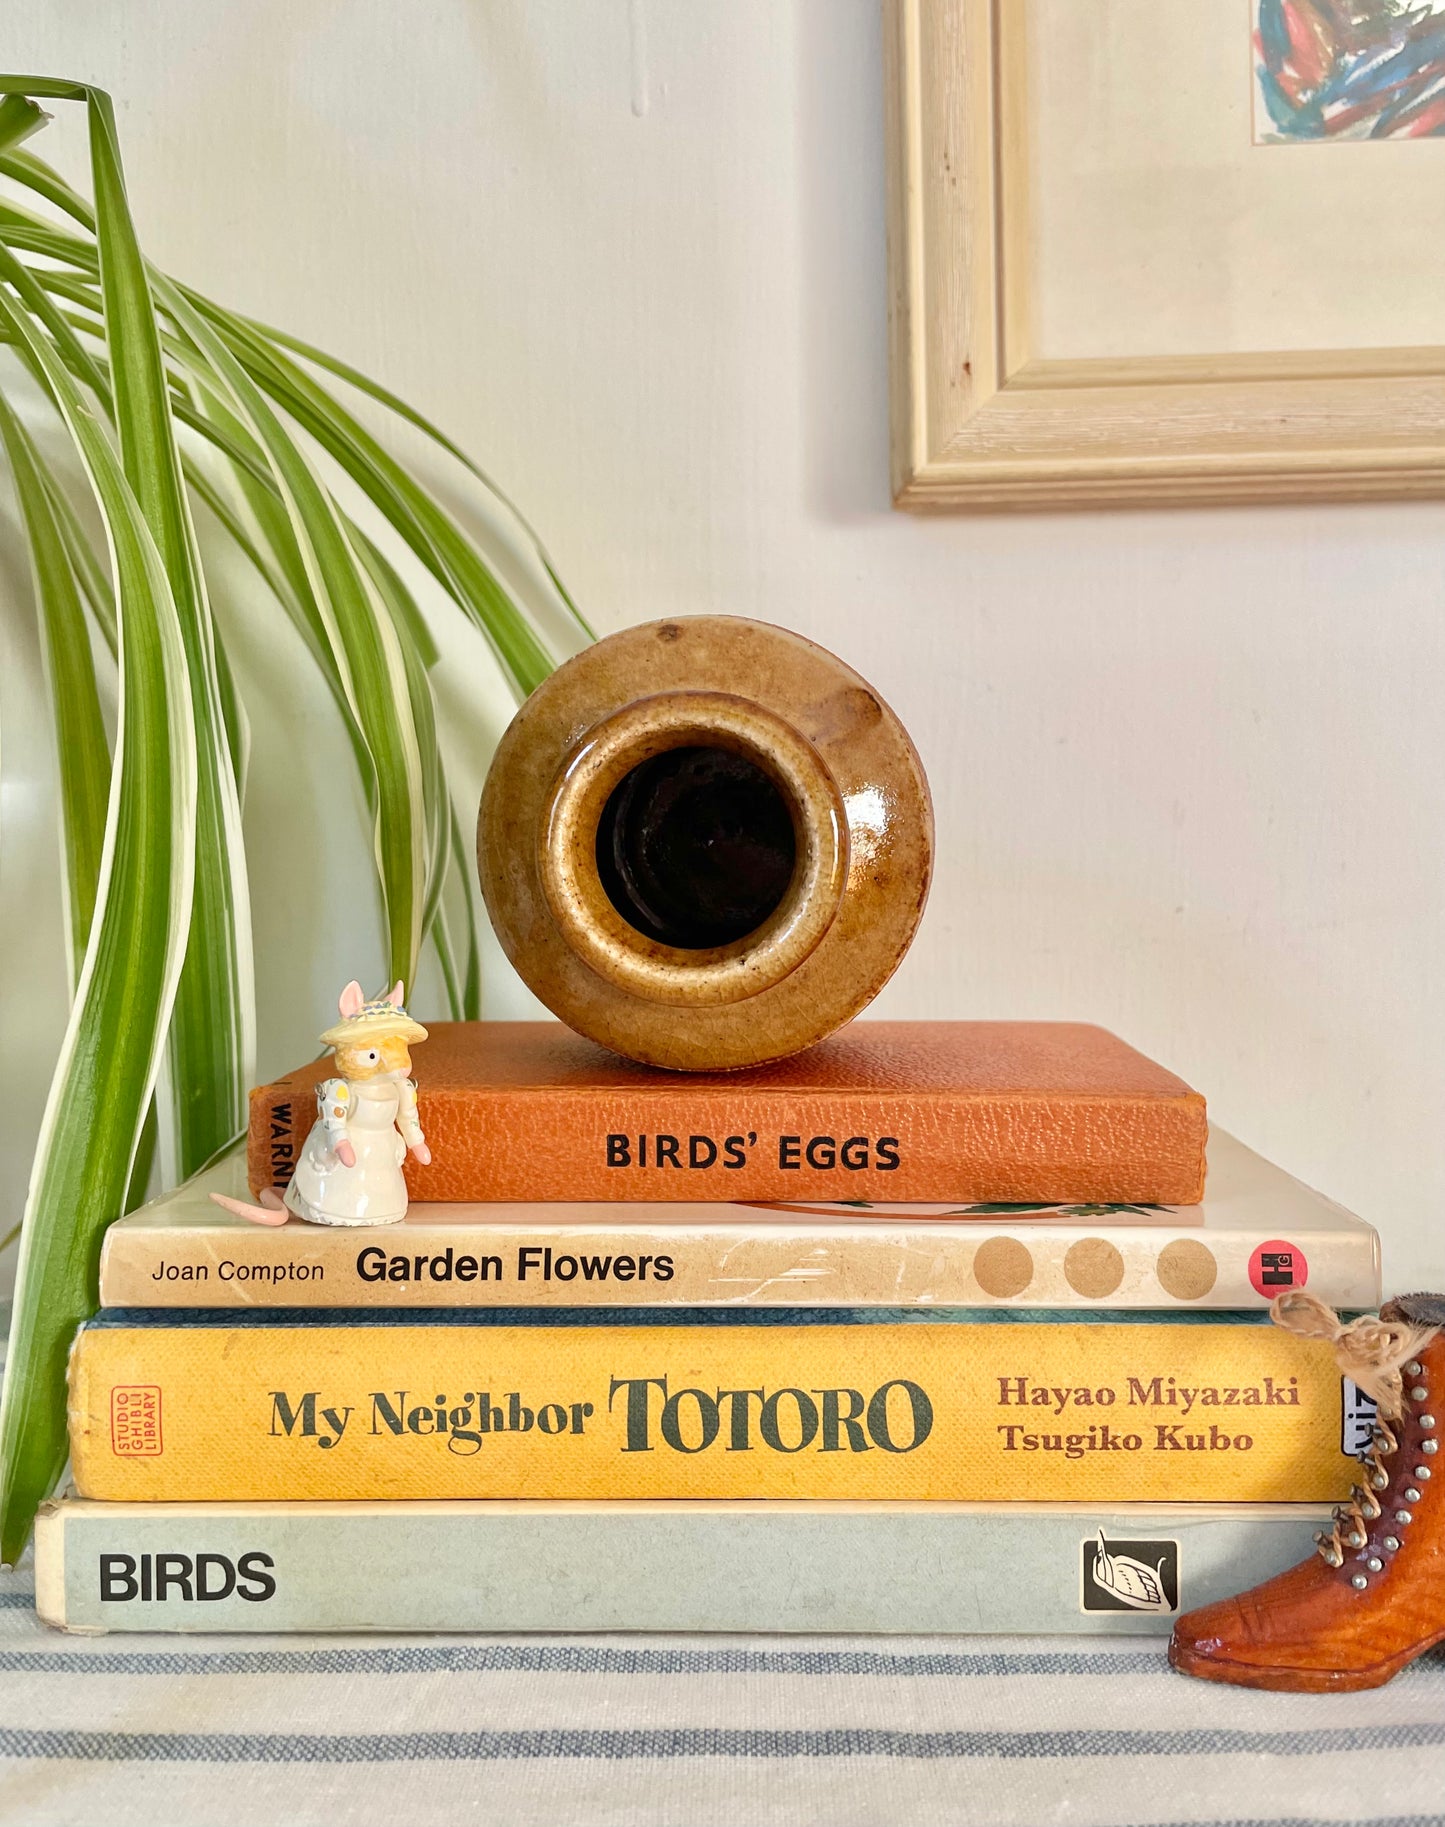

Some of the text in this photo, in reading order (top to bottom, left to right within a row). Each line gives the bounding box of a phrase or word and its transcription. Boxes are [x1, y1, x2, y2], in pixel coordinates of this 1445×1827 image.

[271, 1103, 293, 1188] WARN
[779, 1135, 901, 1170] EGGS
[152, 1260, 325, 1285] Joan Compton
[356, 1247, 675, 1282] Garden Flowers
[267, 1373, 934, 1455] My Neighbor TOTORO
[997, 1376, 1300, 1415] Hayao Miyazaki
[117, 1393, 130, 1450] STUDIO
[130, 1393, 143, 1450] GHIBLI
[144, 1393, 157, 1450] LIBRARY
[997, 1425, 1254, 1459] Tsugiko Kubo
[100, 1552, 276, 1602] BIRDS
